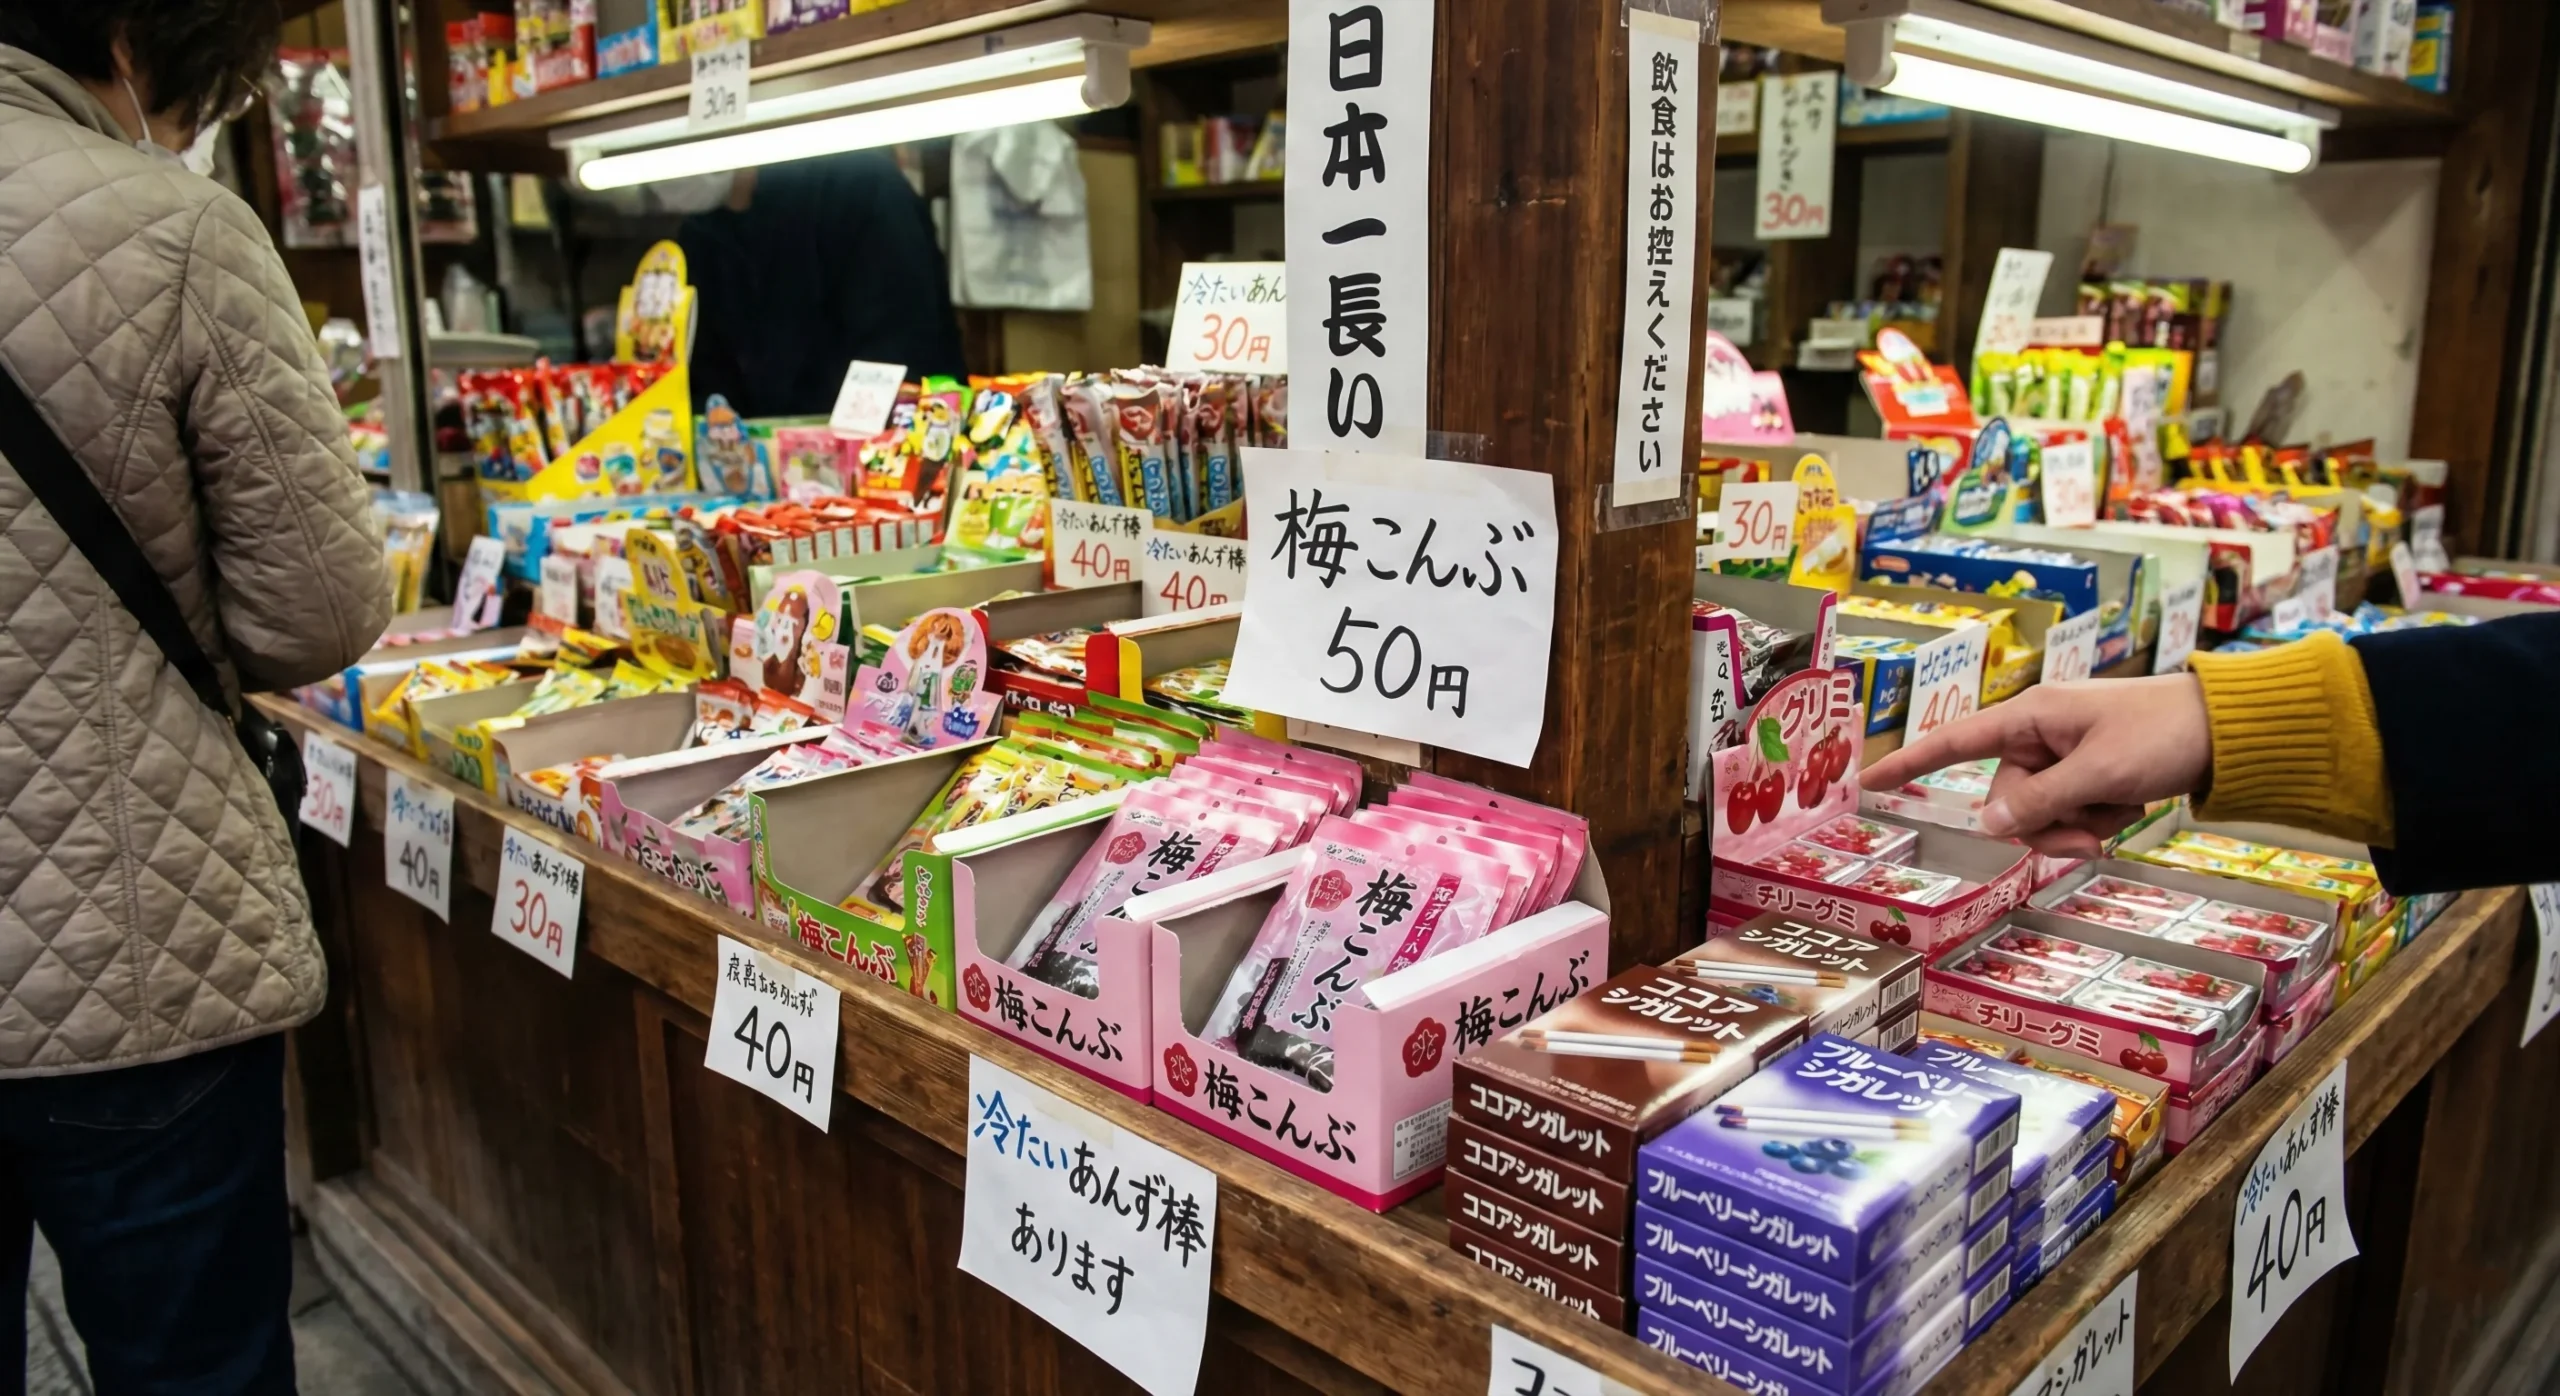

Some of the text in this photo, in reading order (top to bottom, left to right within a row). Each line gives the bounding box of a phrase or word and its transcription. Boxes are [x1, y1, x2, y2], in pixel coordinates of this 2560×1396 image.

[1322, 4, 1388, 440] 日本一長い
[1763, 191, 1825, 230] 30円
[1638, 51, 1679, 474] 飲食はお控えください
[1193, 313, 1271, 363] 30円
[1056, 507, 1142, 541] 冷たいあんず棒
[1070, 538, 1131, 582] 40円
[1146, 536, 1247, 575] 冷たいあんず棒
[1270, 487, 1535, 598] 梅こんぶ
[1728, 499, 1787, 551] 30円
[1319, 606, 1470, 719] 50円
[1917, 684, 1972, 732] 40円
[309, 773, 344, 832] 30円
[399, 839, 440, 900] 40円
[1756, 884, 1858, 932] チリーグミ
[510, 879, 563, 958] 30円
[1290, 868, 1418, 1032] 梅こんぶ
[1738, 928, 1871, 973] シガレット
[1771, 920, 1880, 952] ココア
[994, 974, 1124, 1063] 梅こんぶ
[1452, 949, 1591, 1056] 梅こんぶ
[1600, 987, 1746, 1042] シガレット
[1640, 976, 1760, 1016] ココア
[1974, 1001, 2103, 1058] チリーグミ
[734, 1005, 815, 1105] 40円
[1795, 1058, 1960, 1119] シガレット
[1813, 1040, 1993, 1105] ブルーベリー
[1202, 1058, 1358, 1166] 梅こんぶ
[1469, 1082, 1612, 1159] ココアシガレット
[972, 1089, 1207, 1268] 冷たいあんず棒
[1462, 1137, 1604, 1216] ココアシガレット
[2239, 1082, 2340, 1227] 冷たいあんず棒
[1461, 1192, 1600, 1272] ココアシガレット
[1646, 1167, 1841, 1264] ブルーベリーシガレット
[2246, 1188, 2327, 1314] 40円
[1011, 1202, 1136, 1316] あります
[1644, 1221, 1837, 1321] ブルーベリーシガレット
[1643, 1273, 1834, 1375] ブルーベリーシガレット
